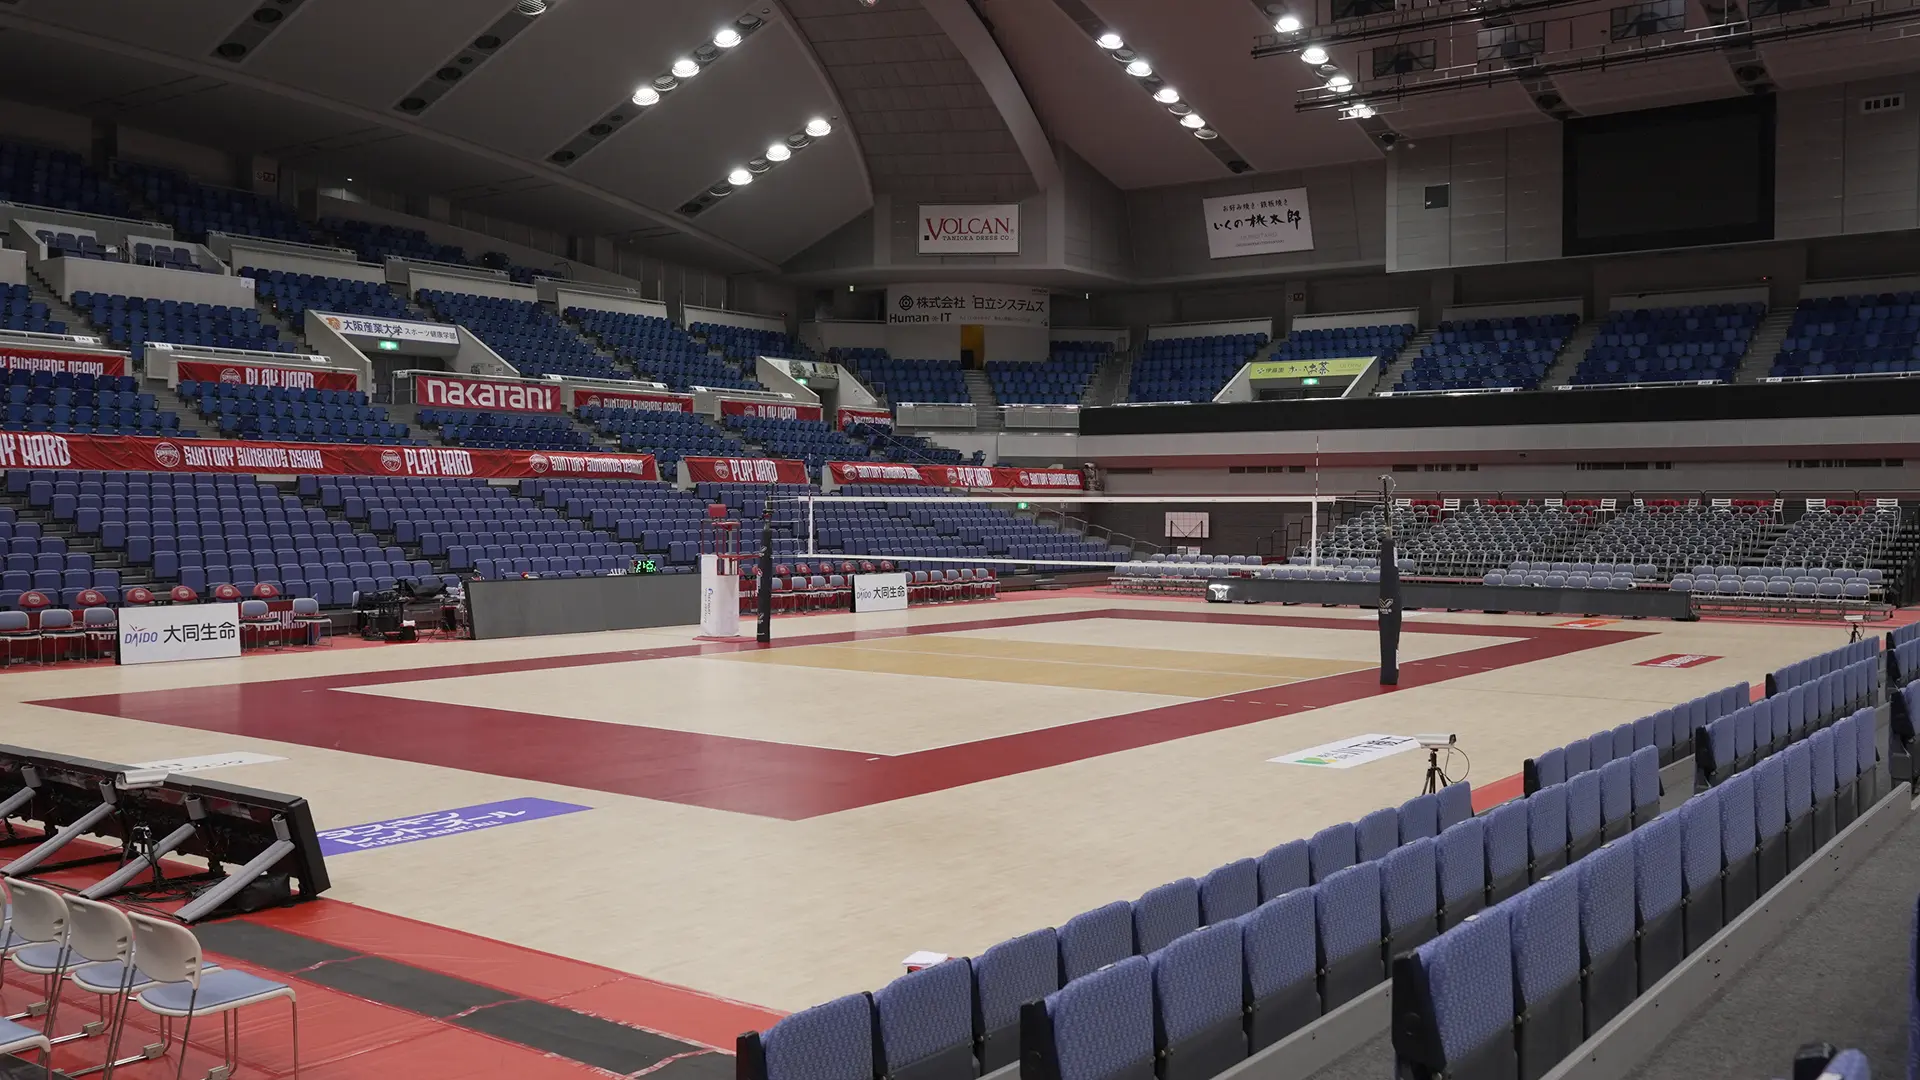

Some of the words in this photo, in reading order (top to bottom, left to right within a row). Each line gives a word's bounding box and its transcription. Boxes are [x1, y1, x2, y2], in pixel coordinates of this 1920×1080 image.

[925, 217, 1009, 240] VOLCAN
[1213, 209, 1302, 230] いくの桃太郎
[916, 296, 966, 309] 株式会社
[973, 296, 1044, 312] 日立システムズ
[343, 320, 403, 336] 大阪産業大学
[889, 313, 930, 323] Human
[940, 312, 952, 322] IT
[18, 434, 71, 466] HARD
[183, 446, 235, 467] SUNTORY
[237, 447, 289, 468] SUNBIRDS
[288, 450, 323, 468] OSAKA
[403, 448, 438, 474] PLAY
[438, 450, 473, 475] HARD
[729, 459, 755, 481] PLAY
[753, 460, 779, 483] HARD
[873, 585, 906, 599] 大同生命
[124, 630, 159, 647] DAIDO
[163, 621, 236, 644] 大同生命
